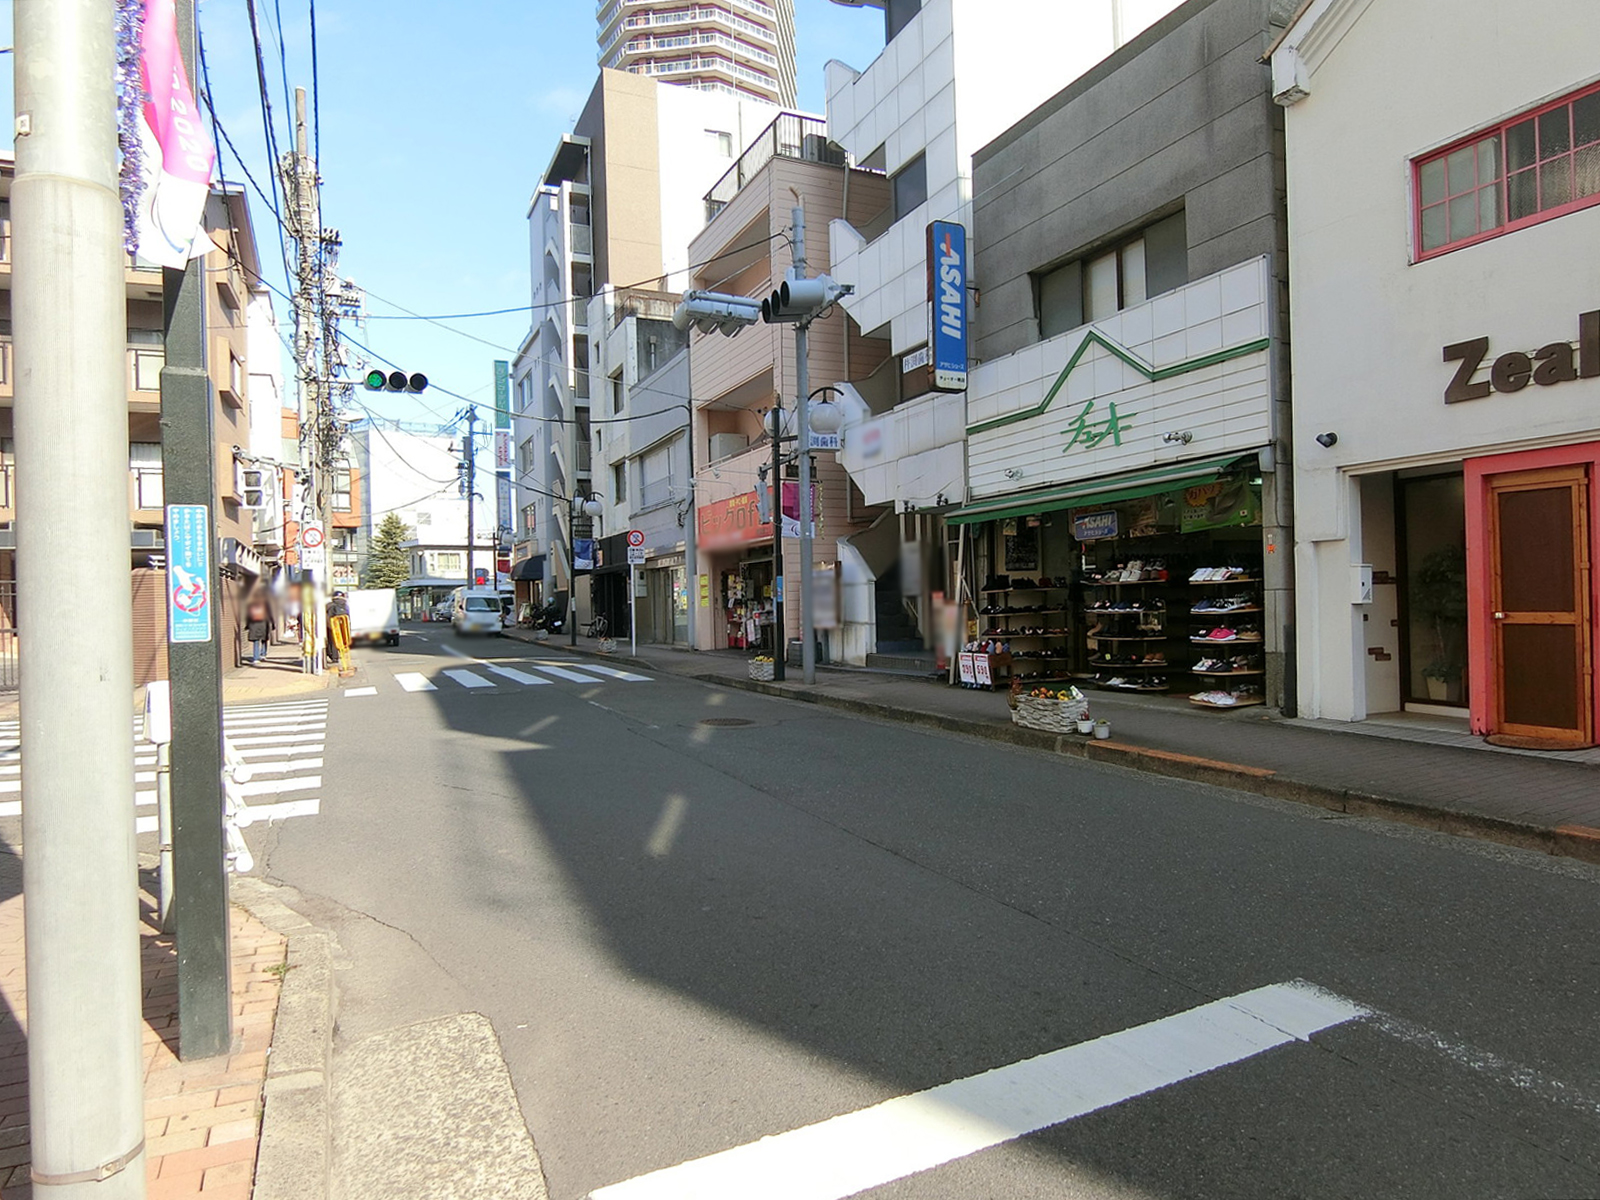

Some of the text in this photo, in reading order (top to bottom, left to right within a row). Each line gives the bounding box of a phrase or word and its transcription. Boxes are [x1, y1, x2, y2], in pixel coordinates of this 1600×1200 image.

[939, 234, 962, 340] ASAHI
[1443, 309, 1600, 404] Zeal
[1081, 514, 1113, 530] ASAHI
